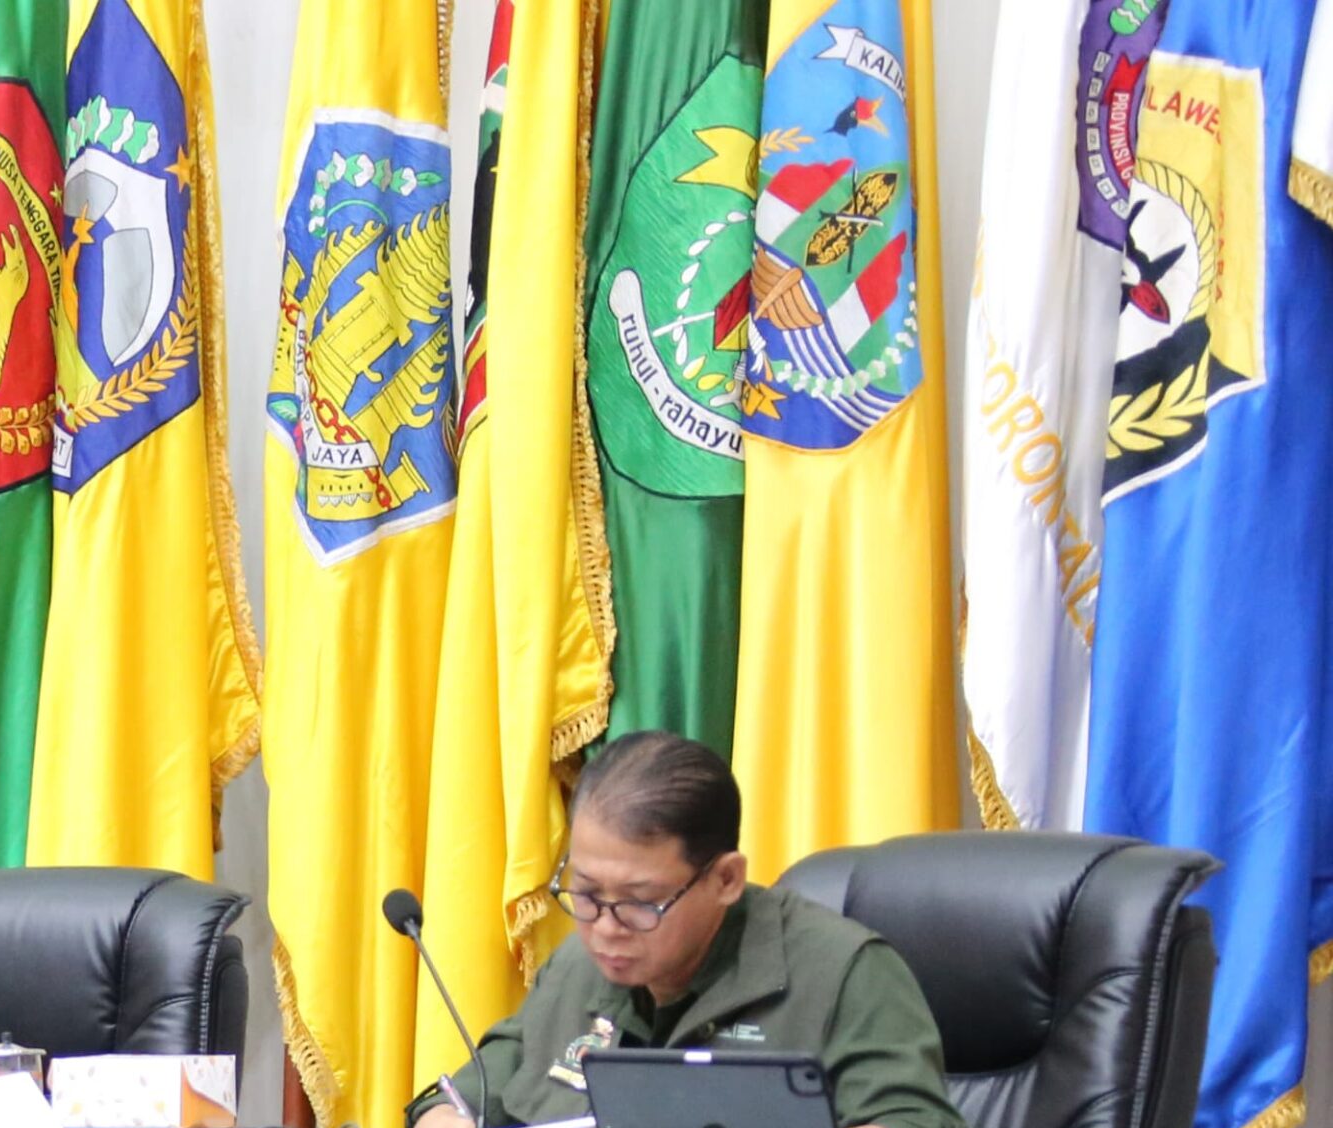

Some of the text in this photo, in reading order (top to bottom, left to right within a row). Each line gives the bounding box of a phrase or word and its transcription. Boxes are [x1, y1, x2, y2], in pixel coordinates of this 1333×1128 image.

[1108, 91, 1131, 166] PROVINSI
[17, 183, 58, 266] TENGGARA
[621, 313, 658, 384] ruhul
[659, 395, 743, 453] rahayu
[312, 447, 363, 464] JAYA
